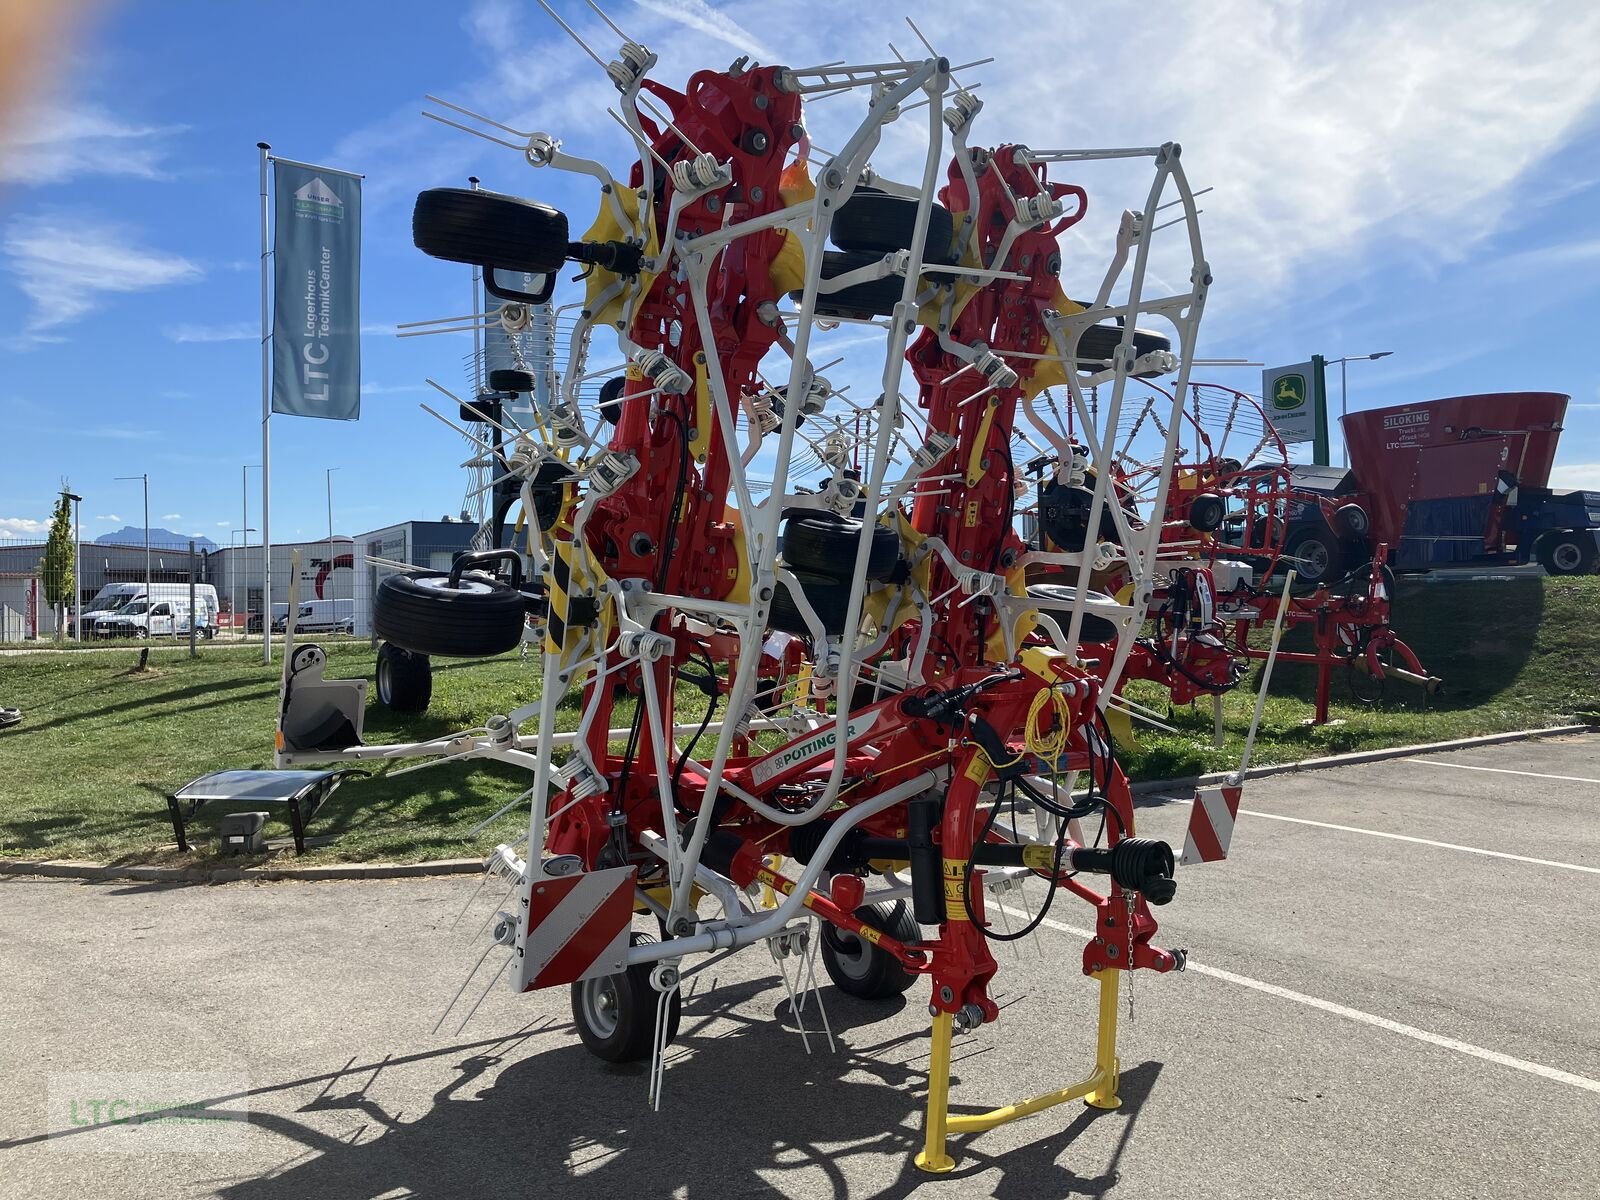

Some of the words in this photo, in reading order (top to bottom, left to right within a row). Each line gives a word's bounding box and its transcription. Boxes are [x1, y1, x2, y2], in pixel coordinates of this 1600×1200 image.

[303, 269, 318, 337] Lagerhaus
[319, 246, 331, 339] TechnikCenter
[303, 342, 330, 401] LTC
[1383, 412, 1430, 427] SILOKING
[1386, 442, 1400, 450] LTC
